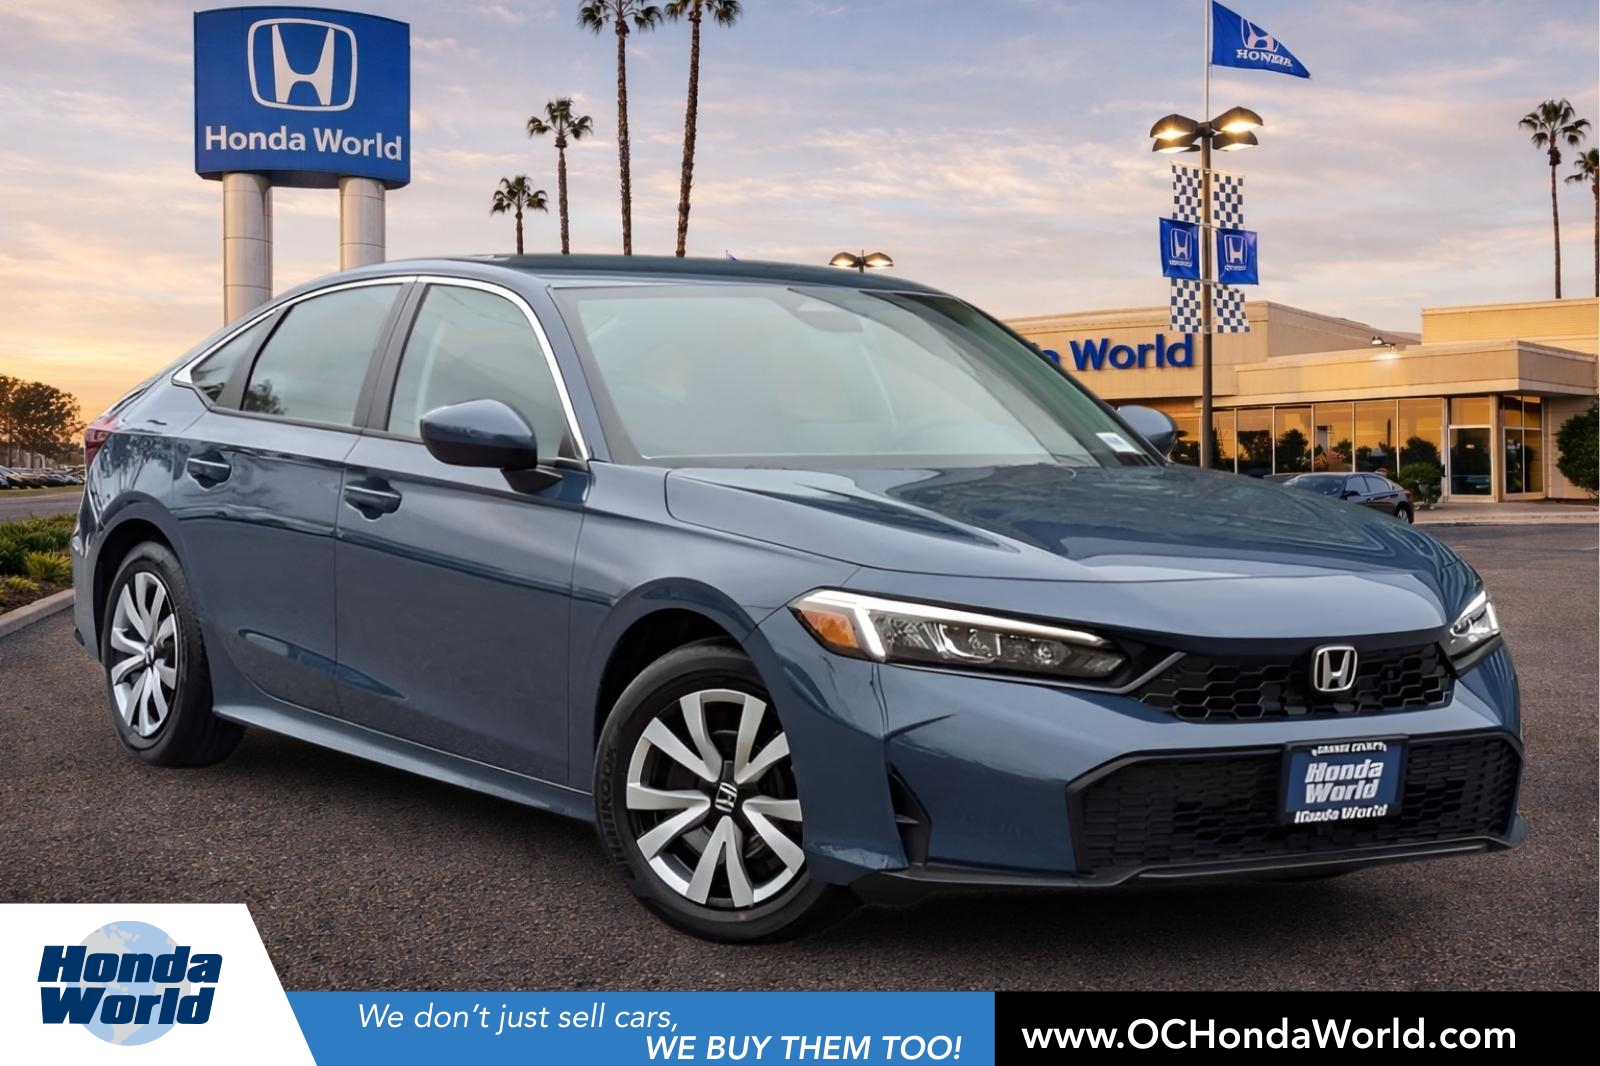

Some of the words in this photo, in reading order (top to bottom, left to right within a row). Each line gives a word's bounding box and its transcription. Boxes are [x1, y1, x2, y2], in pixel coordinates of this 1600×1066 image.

[205, 125, 306, 151] Honda
[313, 127, 402, 161] World
[1069, 332, 1194, 371] World
[1305, 758, 1384, 783] Honda
[1305, 778, 1380, 804] World
